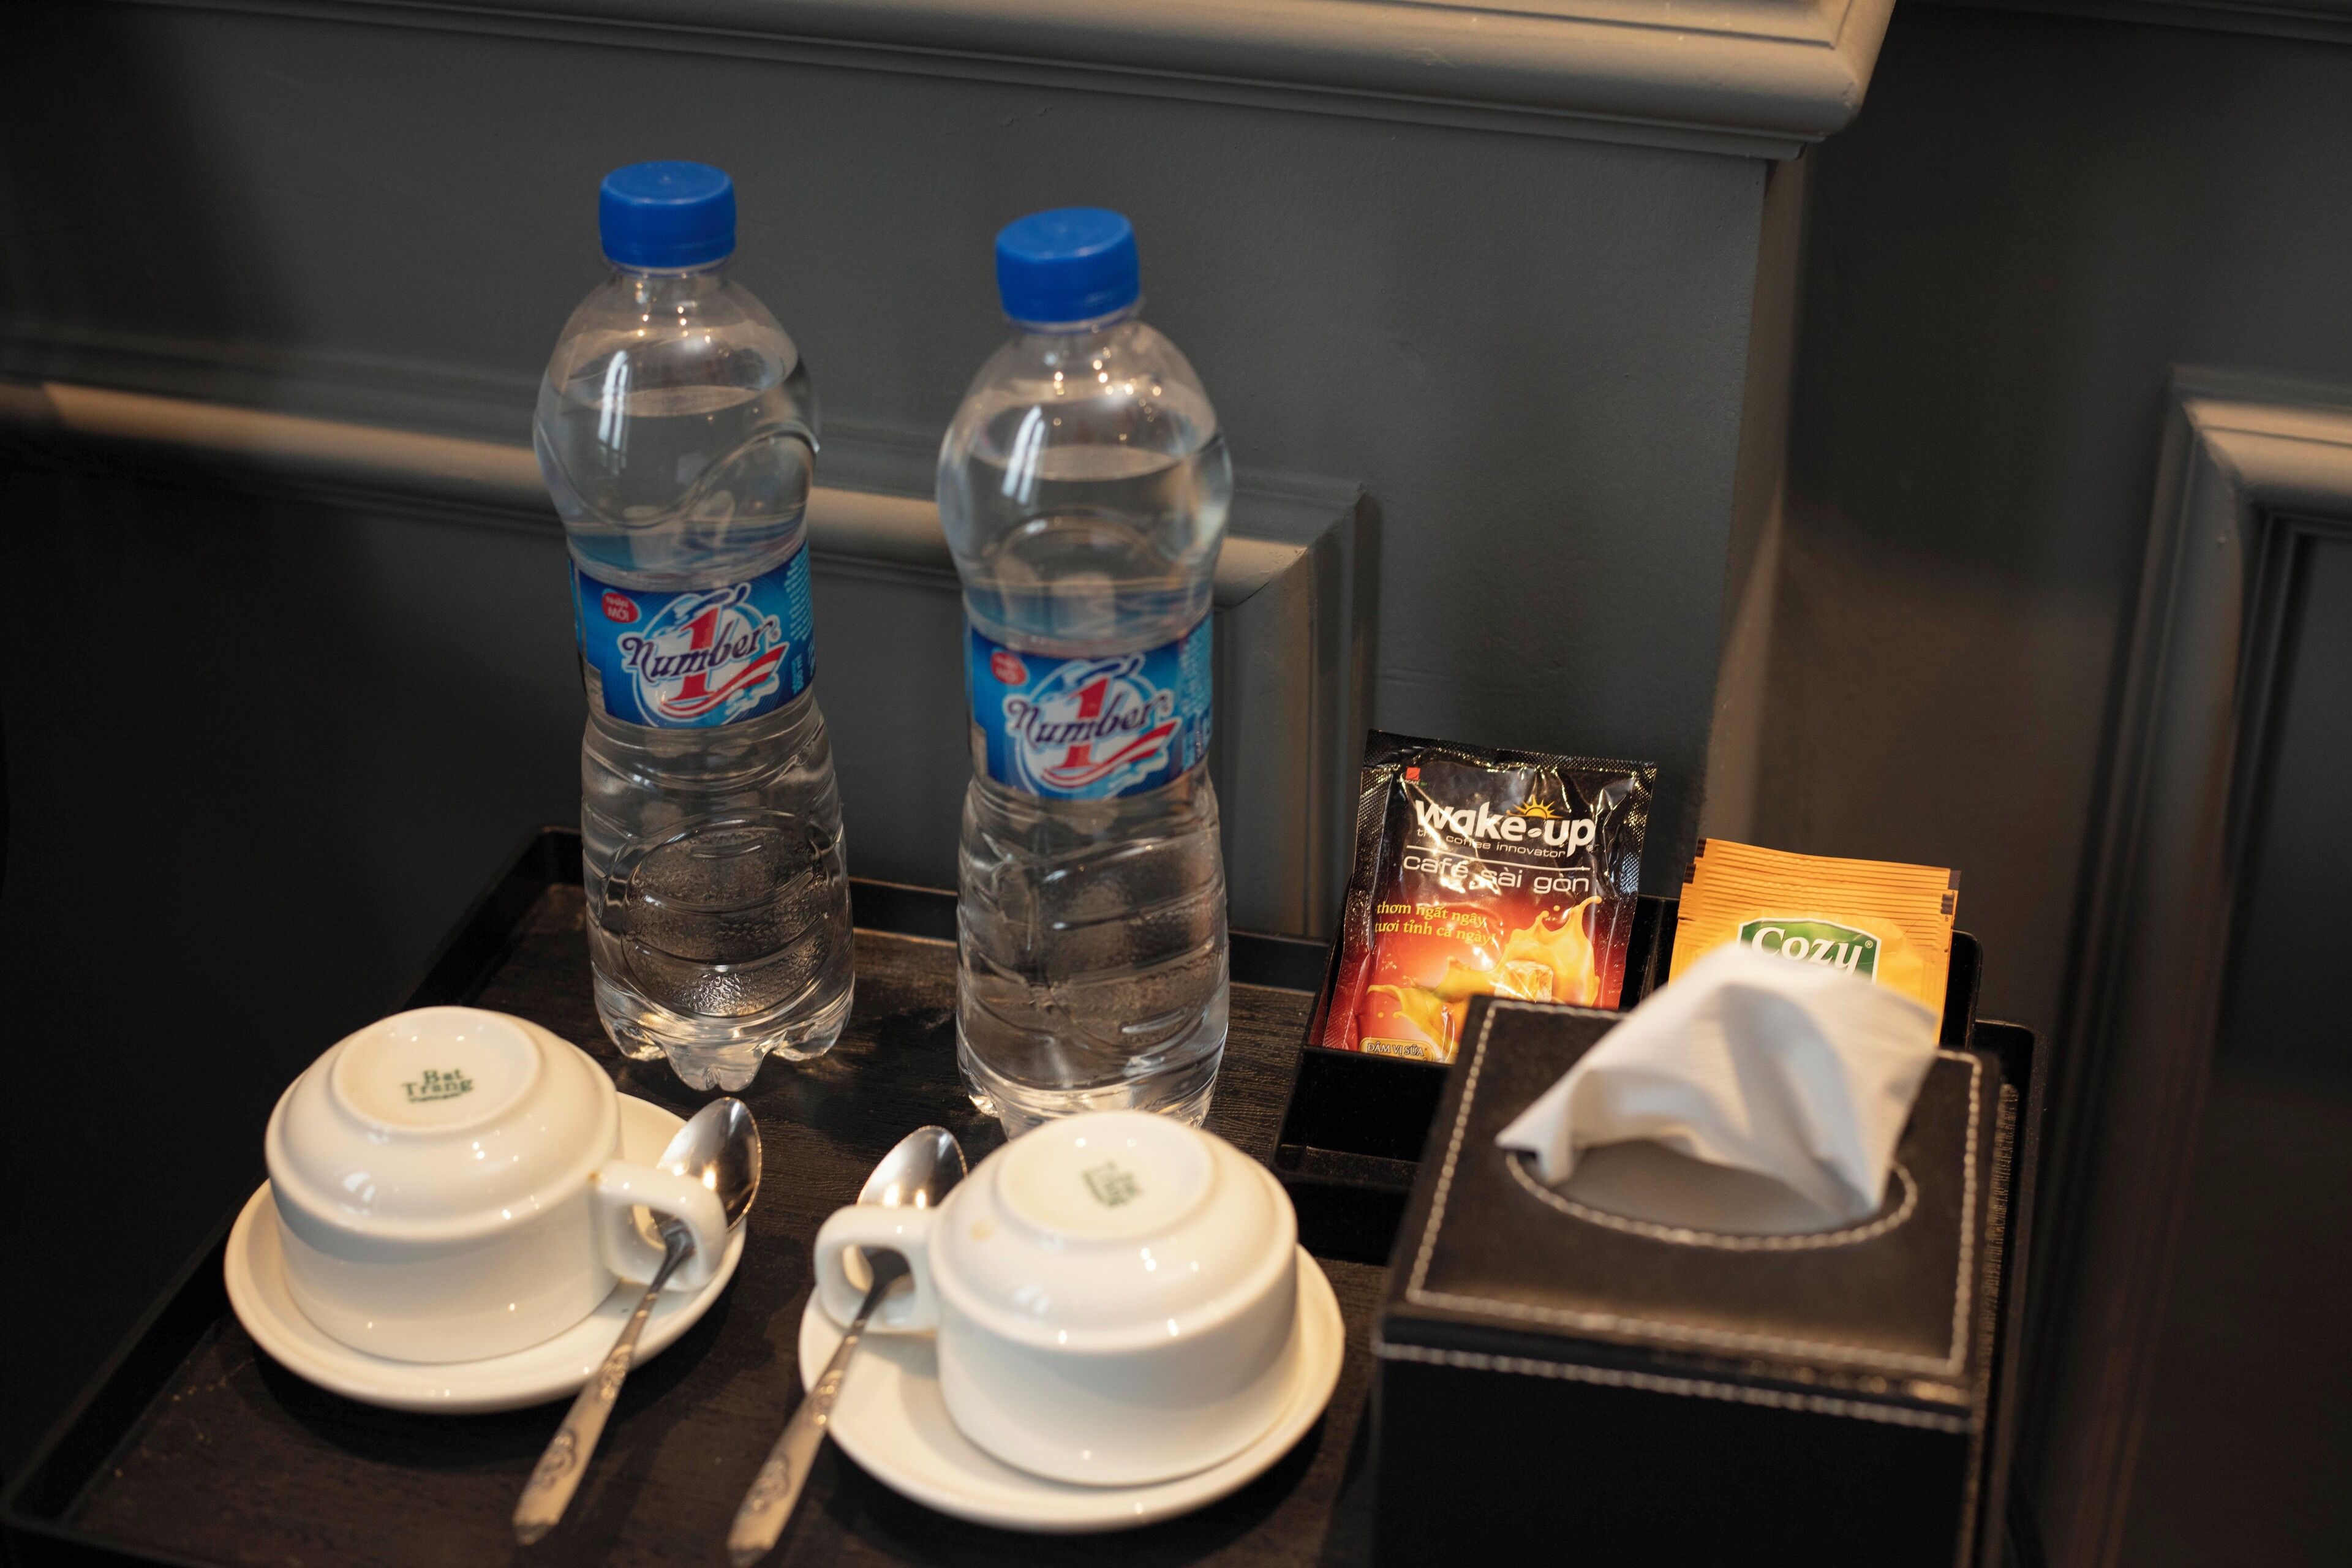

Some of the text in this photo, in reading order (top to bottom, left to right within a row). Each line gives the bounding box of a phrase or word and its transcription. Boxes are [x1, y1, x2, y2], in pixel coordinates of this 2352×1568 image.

[622, 620, 774, 681] Number
[1007, 693, 1168, 749] Number
[1496, 842, 1566, 858] innovator
[1403, 855, 1469, 879] café
[1480, 866, 1523, 888] sài
[1376, 900, 1411, 914] thơm
[1415, 905, 1449, 921] ngất
[1374, 919, 1400, 933] tươi
[1403, 919, 1433, 936] tỉnh
[1750, 926, 1864, 975] Cozy
[1392, 1044, 1403, 1056] VỊ
[1404, 1044, 1424, 1057] SỮA
[401, 1079, 474, 1096] Trang
